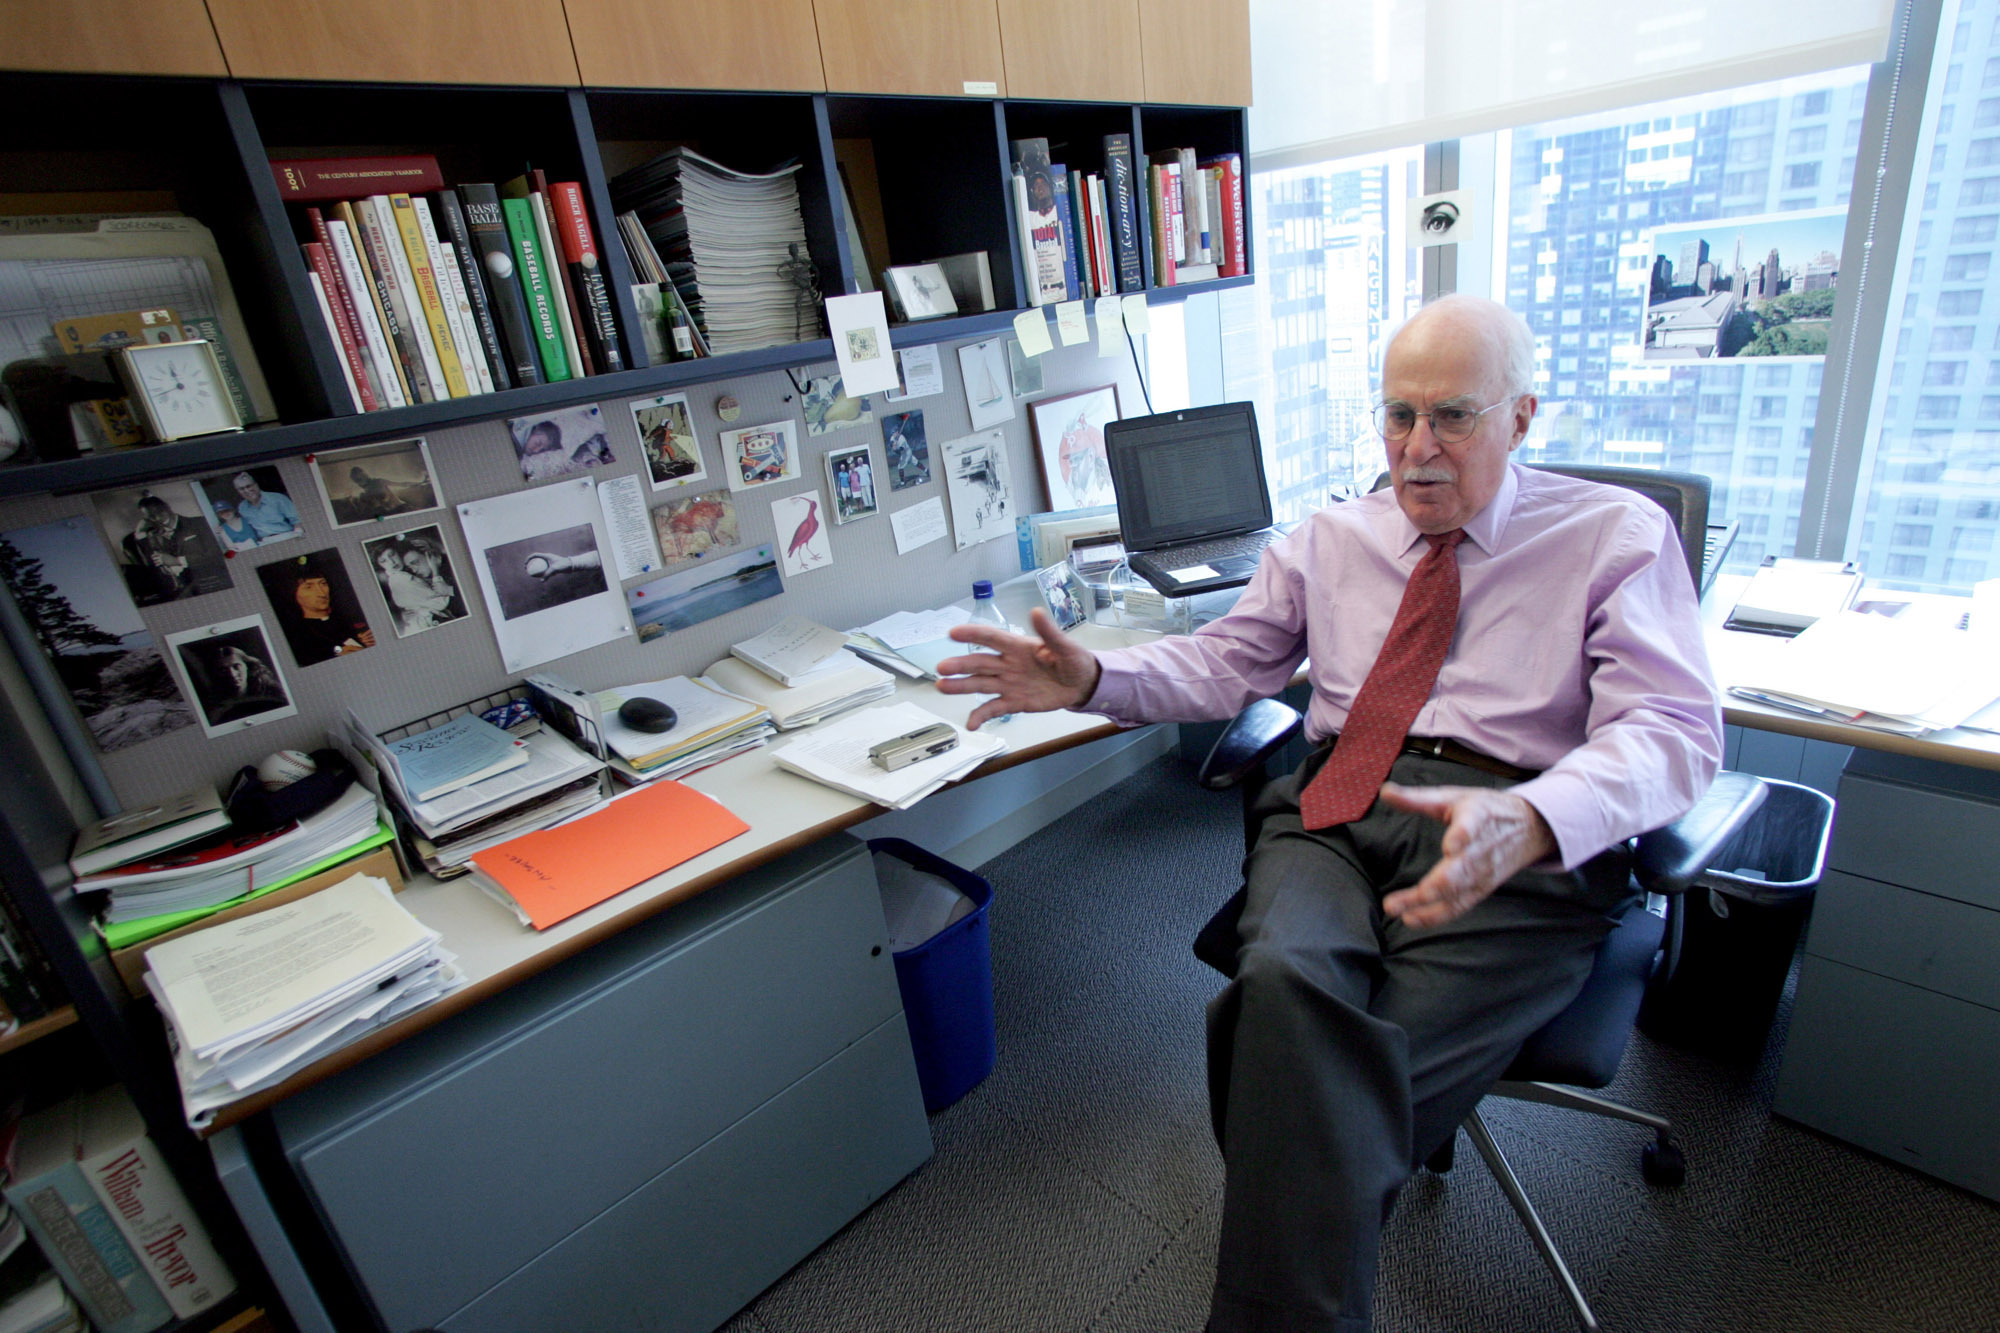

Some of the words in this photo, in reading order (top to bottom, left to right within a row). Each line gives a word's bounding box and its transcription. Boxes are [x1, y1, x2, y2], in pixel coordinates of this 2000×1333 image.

[317, 172, 331, 180] THE
[369, 226, 382, 243] HERE
[566, 187, 582, 215] ROGER
[574, 216, 590, 250] ANGELL
[378, 253, 391, 273] YOUR
[384, 273, 397, 290] WAR
[520, 239, 543, 292] BASEBALL
[534, 293, 555, 340] RECORDS
[589, 272, 609, 307] GAME
[1367, 238, 1380, 337] ARGENT
[375, 279, 401, 335] CHICAGO
[459, 245, 471, 265] MAY
[465, 267, 477, 284] THE
[471, 287, 483, 308] BEST
[478, 310, 491, 335] TEAM
[486, 336, 497, 355] WIN
[598, 307, 617, 340] TIME
[97, 1148, 146, 1220] William
[143, 1223, 199, 1290] Trevor
